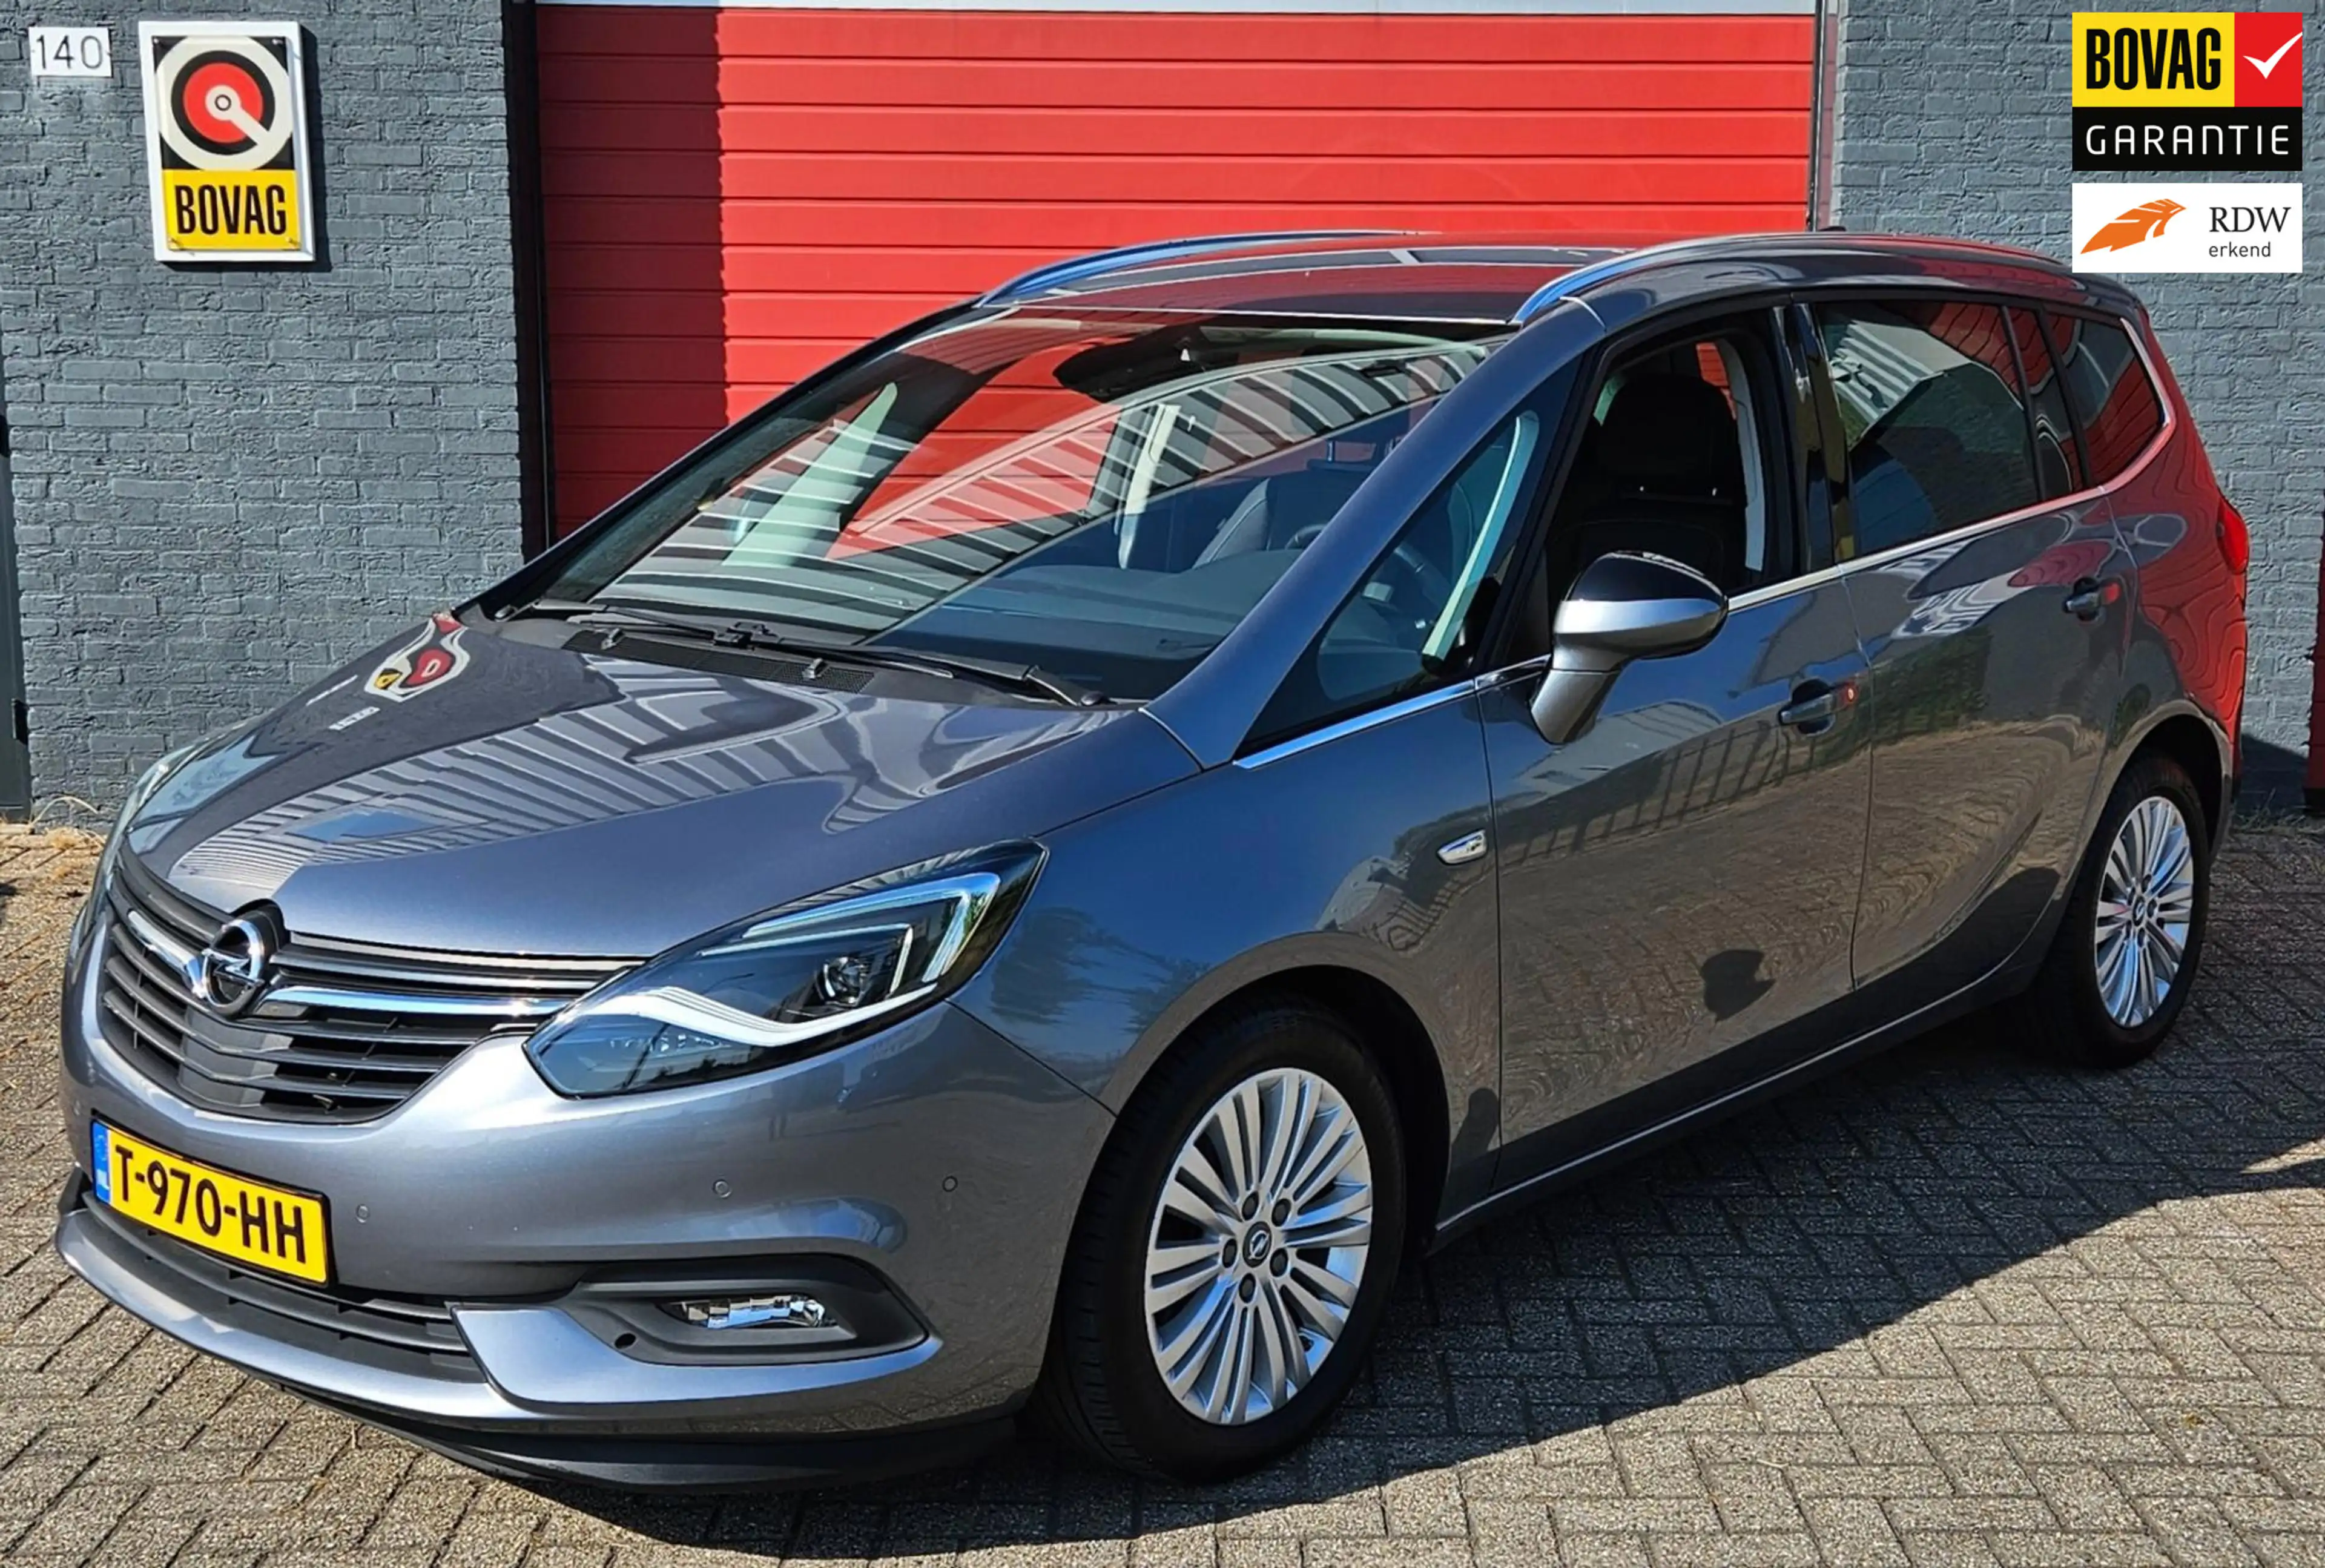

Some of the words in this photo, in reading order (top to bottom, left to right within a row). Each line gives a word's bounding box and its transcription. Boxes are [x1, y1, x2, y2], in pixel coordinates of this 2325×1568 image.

[35, 34, 104, 70] 140
[174, 184, 286, 235] BOVAG
[115, 1144, 306, 1264] T-970-HH
